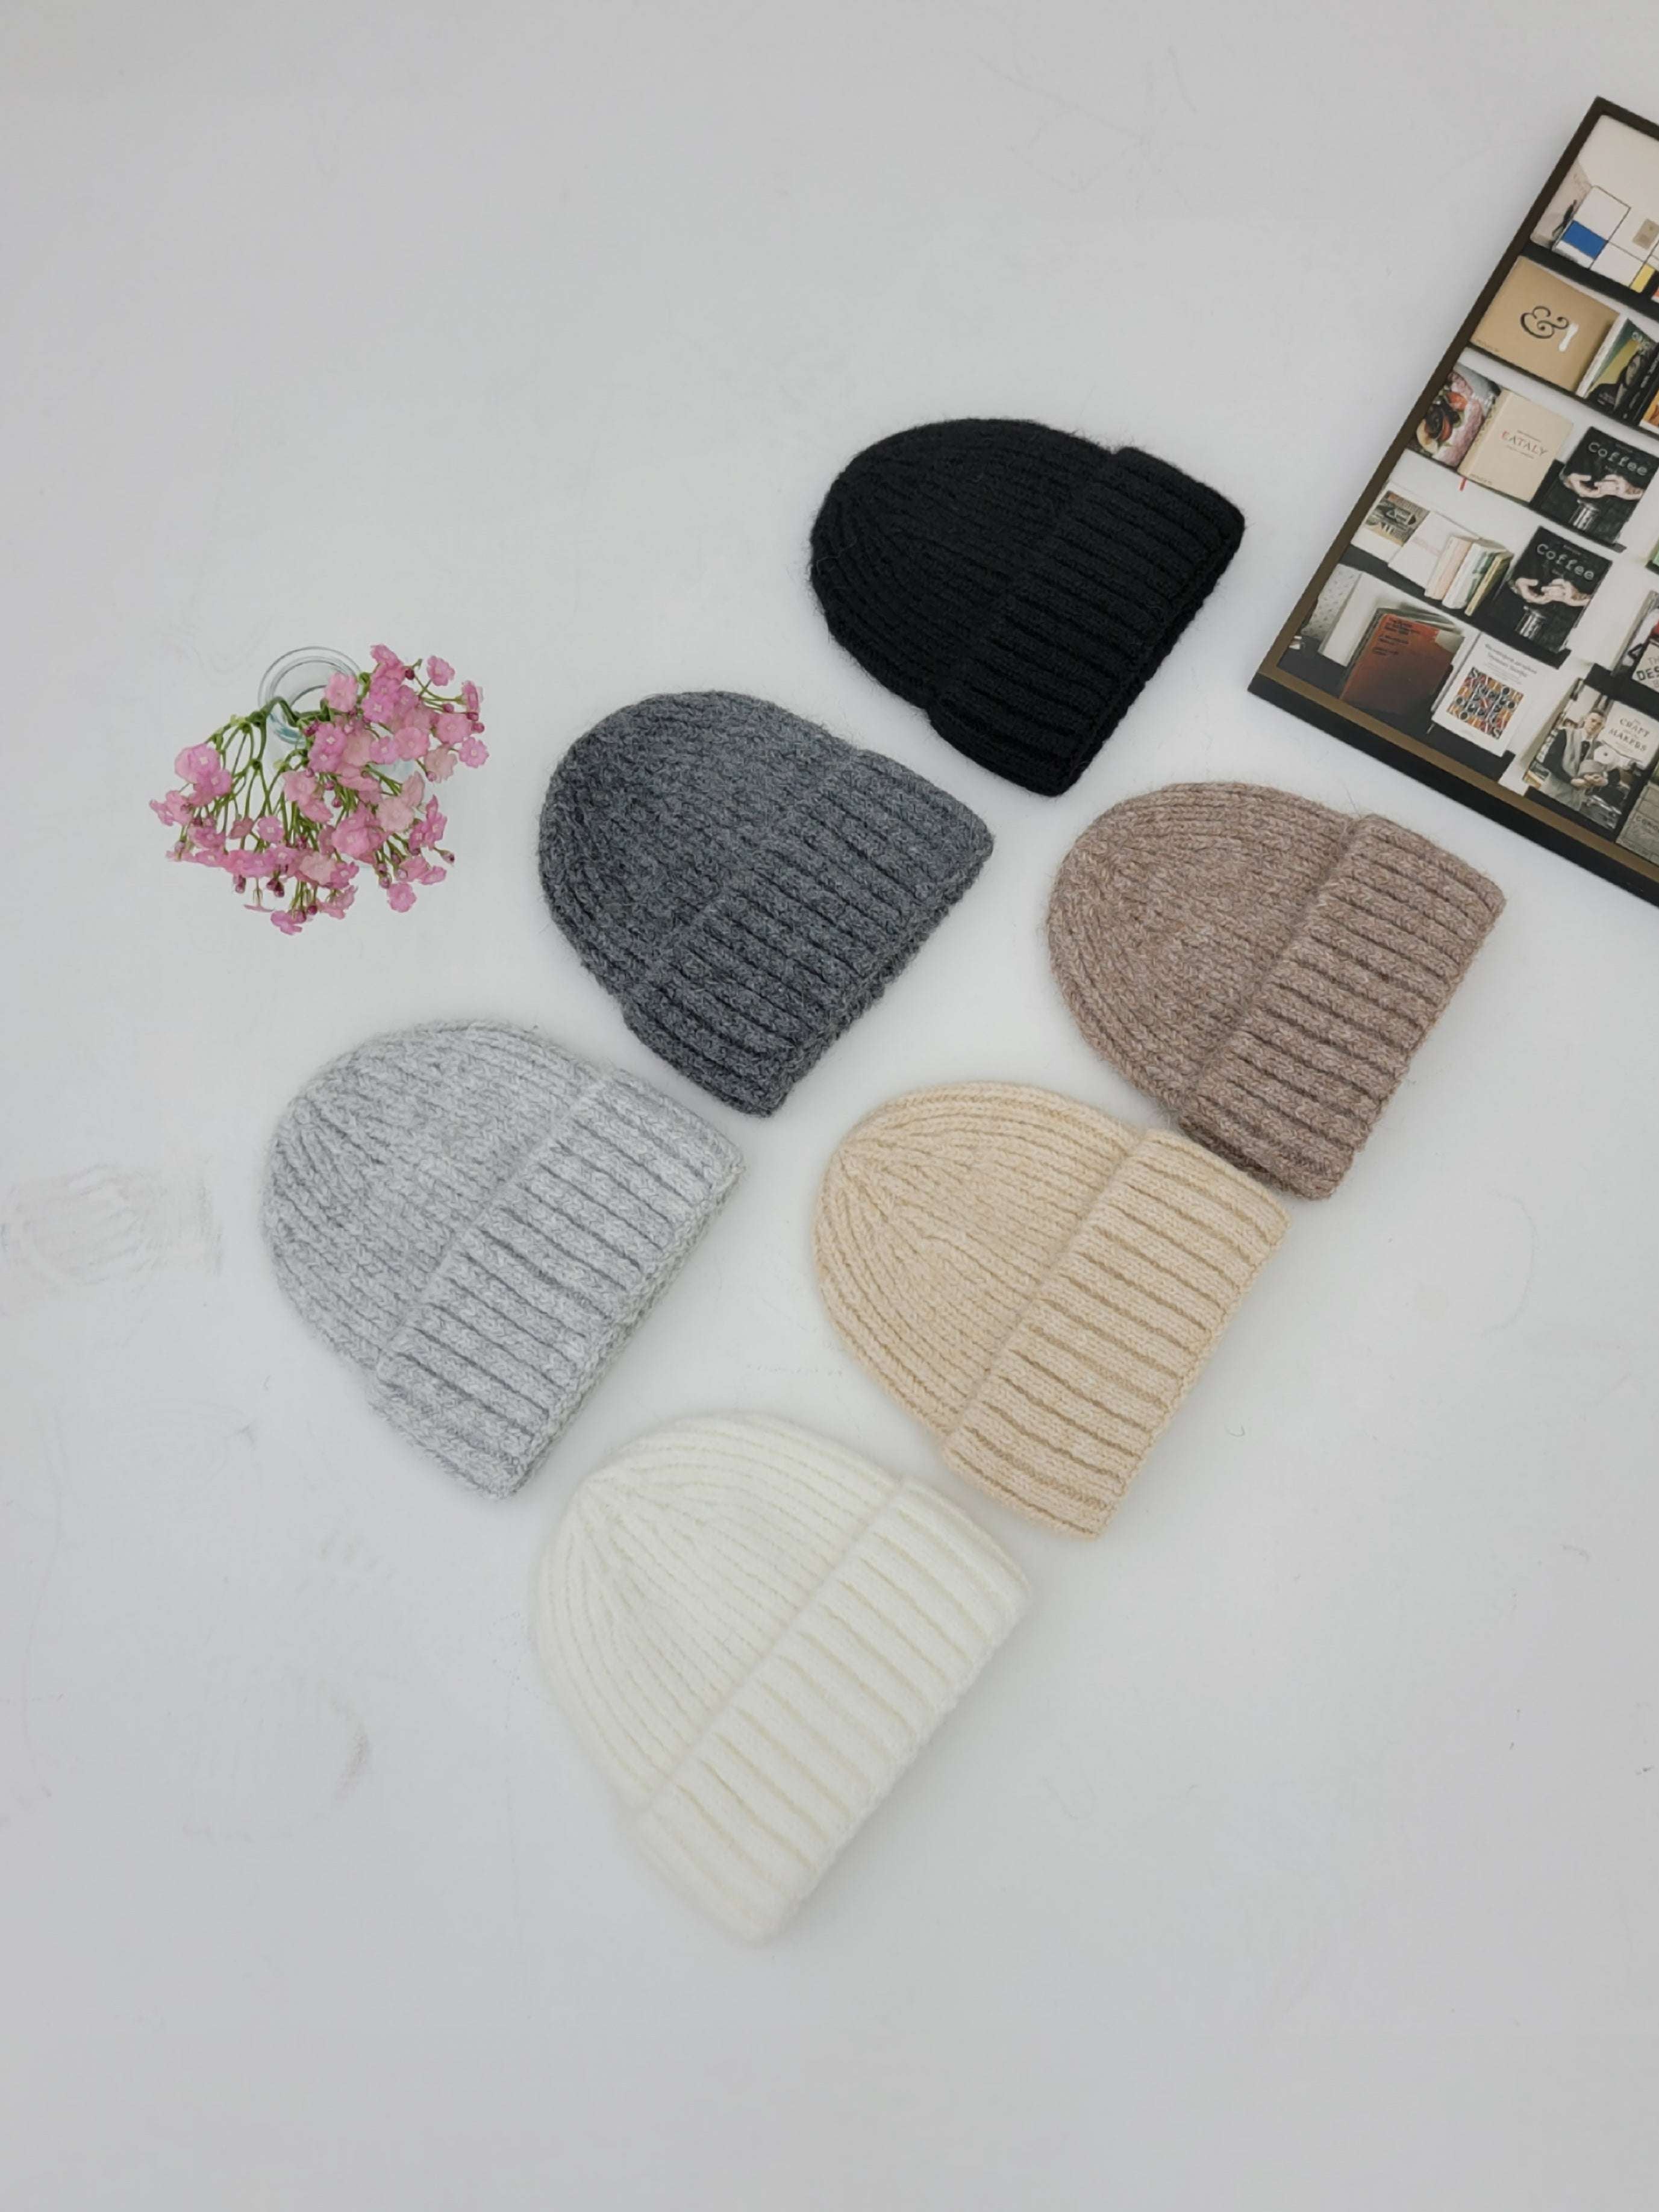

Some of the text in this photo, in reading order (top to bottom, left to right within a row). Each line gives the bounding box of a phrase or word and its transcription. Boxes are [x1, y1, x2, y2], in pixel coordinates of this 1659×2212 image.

[1501, 430, 1548, 456] EATALY
[1588, 442, 1648, 476] Coffee
[1537, 544, 1595, 580] Coffee
